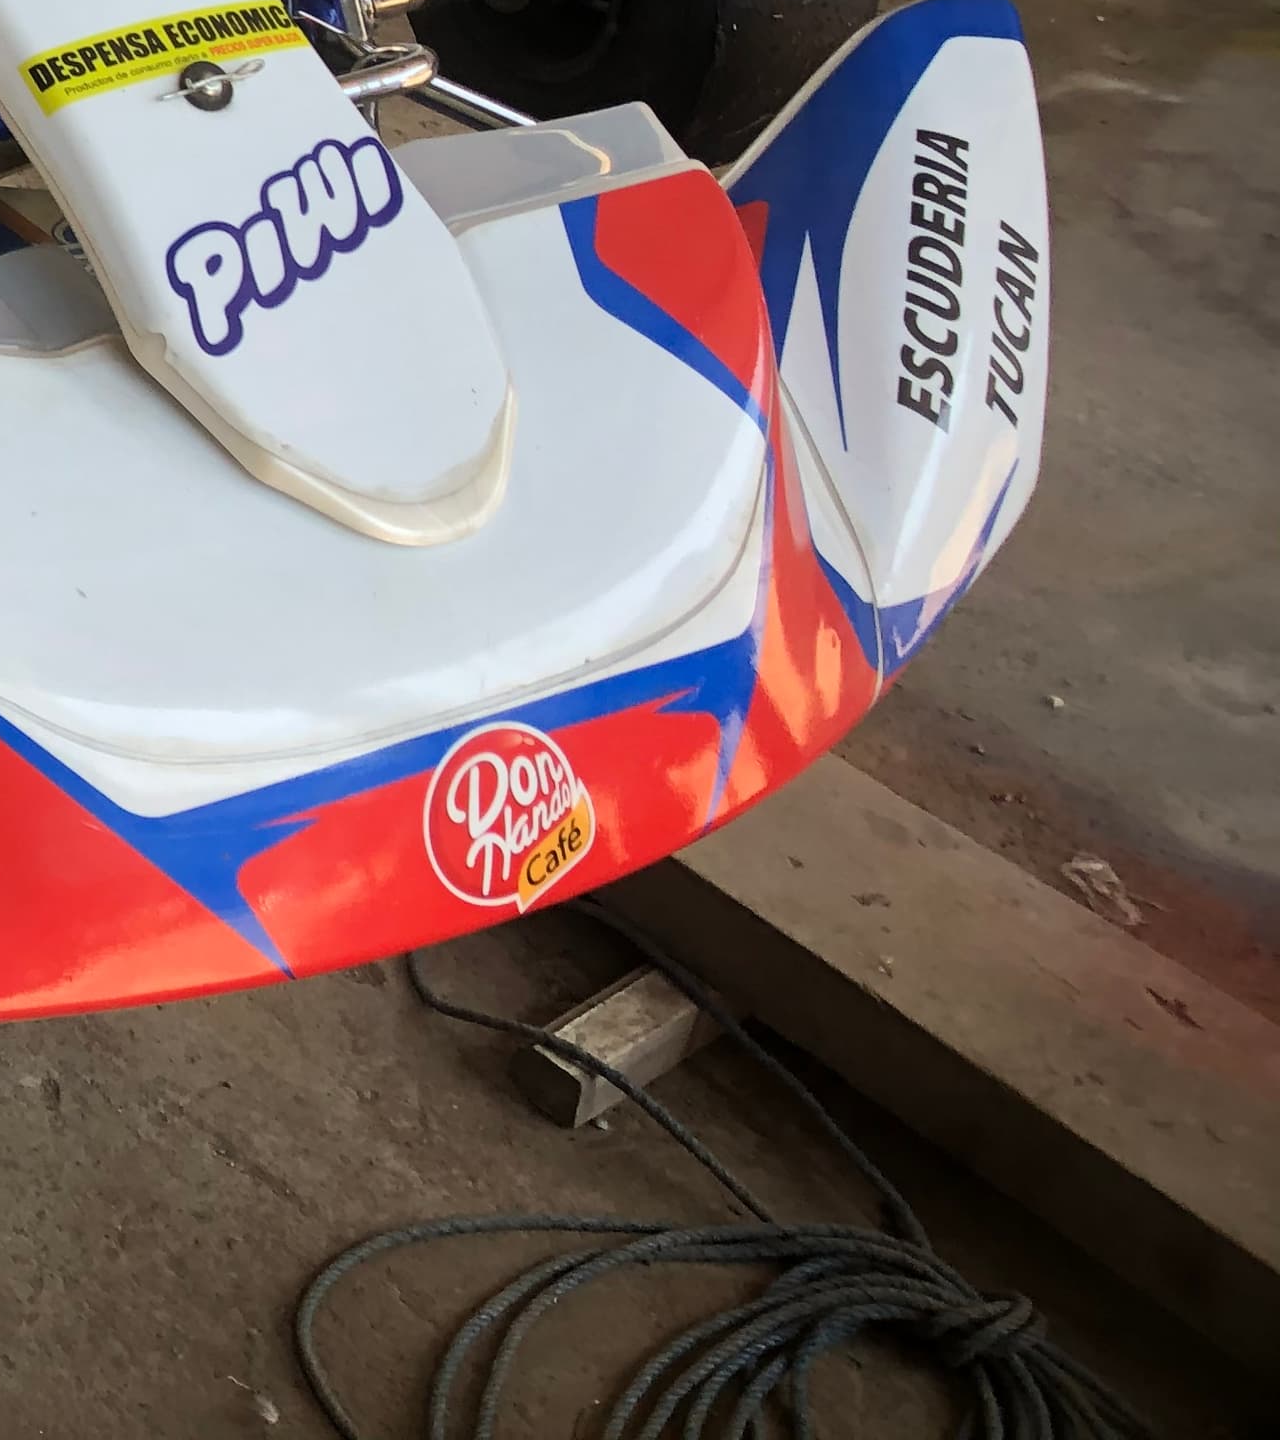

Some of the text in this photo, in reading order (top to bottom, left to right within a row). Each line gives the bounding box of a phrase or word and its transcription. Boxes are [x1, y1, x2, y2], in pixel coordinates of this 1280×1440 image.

[28, 4, 298, 93] DESPENSA ECONOMIC
[63, 75, 114, 96] Productos
[115, 71, 128, 81] de
[130, 60, 172, 77] consumo
[897, 128, 970, 434] ESCUDERIA
[985, 219, 1039, 430] TUCAN
[446, 751, 563, 841] Don
[526, 817, 583, 887] Café
